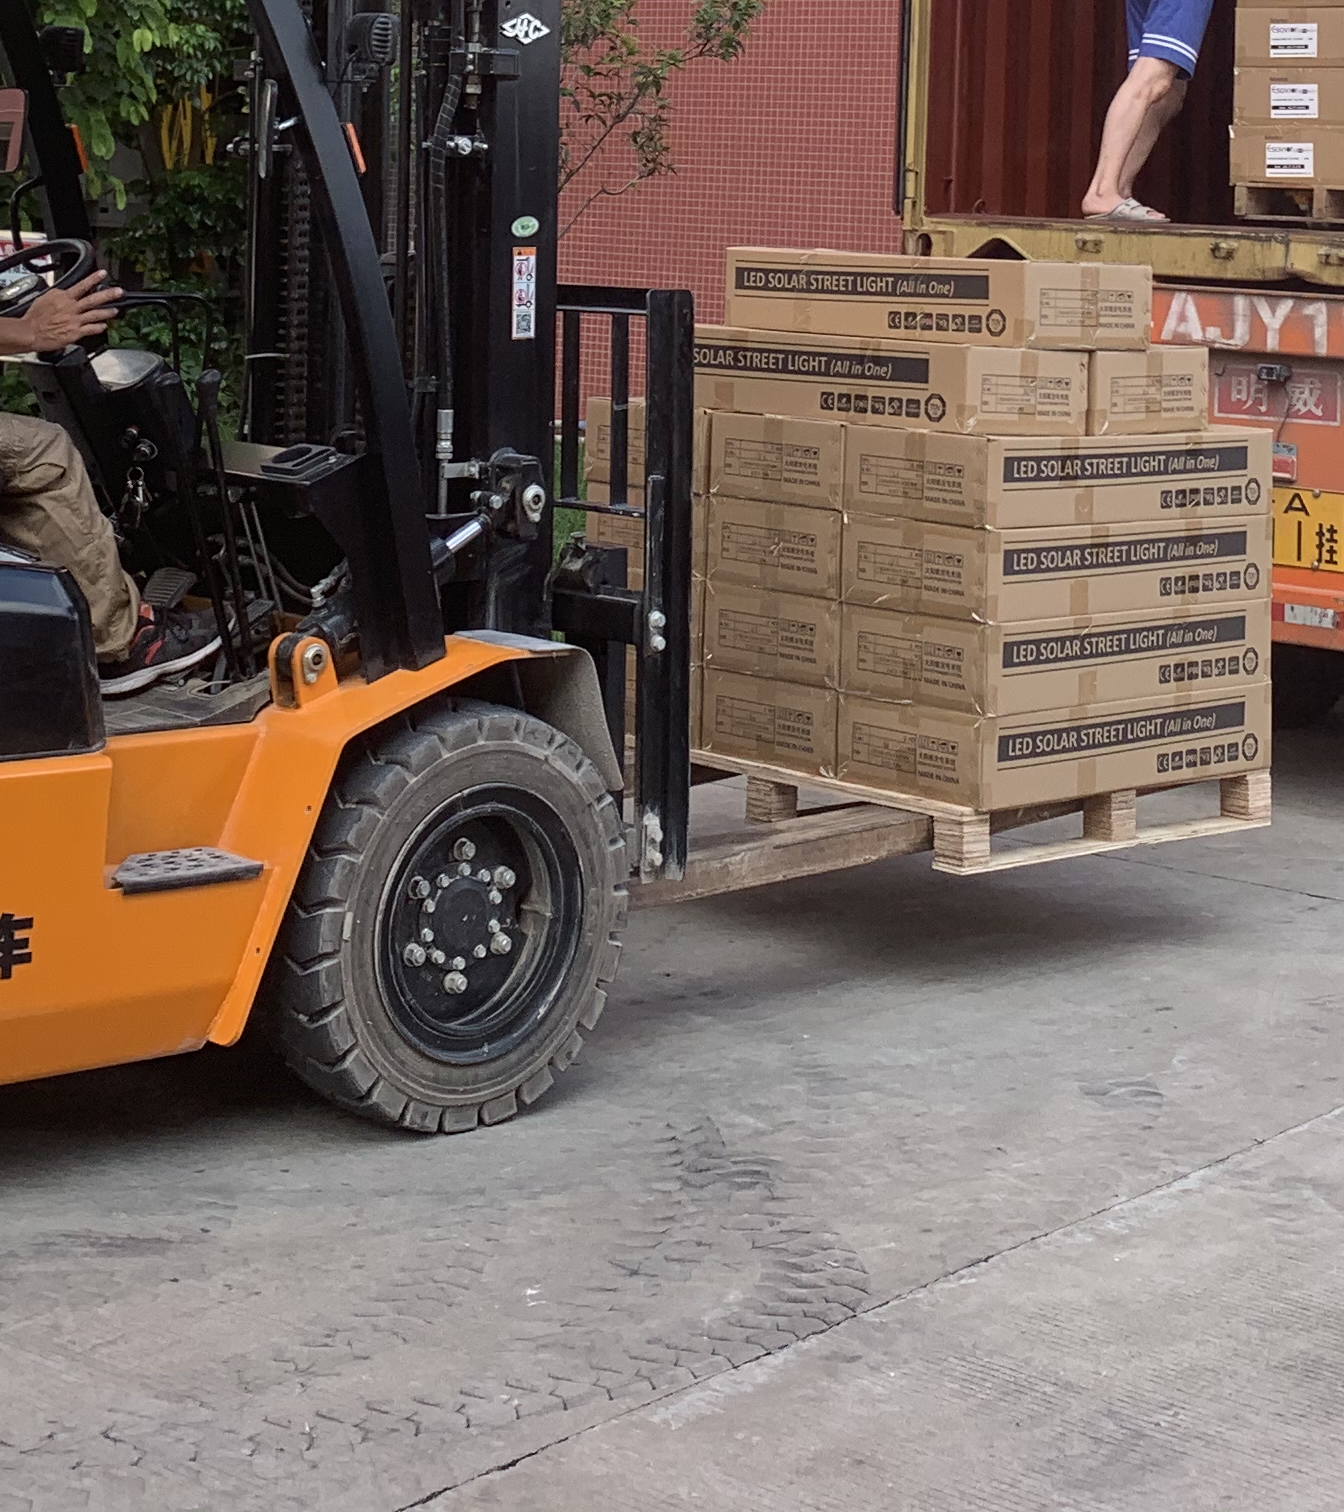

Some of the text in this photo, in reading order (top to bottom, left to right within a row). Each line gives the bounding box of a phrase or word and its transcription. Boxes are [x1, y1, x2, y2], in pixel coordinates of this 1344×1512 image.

[743, 271, 764, 287] LED
[768, 272, 806, 289] SOLAR
[810, 274, 854, 291] STREET
[857, 276, 894, 293] LIGHT
[929, 281, 954, 297] One)
[694, 348, 734, 366] SOLAR
[737, 351, 783, 369] STREET
[788, 355, 827, 373] LIGHT
[864, 362, 892, 379] One)
[1013, 461, 1037, 478] LED
[1040, 459, 1081, 476] SOLAR
[1084, 457, 1128, 475] STREET
[1131, 455, 1166, 472] LIGHT
[1196, 454, 1219, 470] One)
[1283, 492, 1310, 516] A
[1013, 552, 1037, 571] LED
[1040, 550, 1081, 569] SOLAR
[1084, 546, 1128, 565] STREET
[1131, 543, 1166, 561] LIGHT
[1196, 539, 1218, 555] One)
[1012, 644, 1036, 663] LED
[1039, 640, 1080, 660] SOLAR
[1083, 635, 1126, 655] STREET
[1130, 630, 1164, 649] LIGHT
[1194, 625, 1217, 642] One)
[1008, 738, 1033, 756] LED
[1035, 733, 1076, 753] SOLAR
[1080, 725, 1125, 747] STREET
[1127, 719, 1163, 739] LIGHT
[1193, 713, 1216, 729] One)
